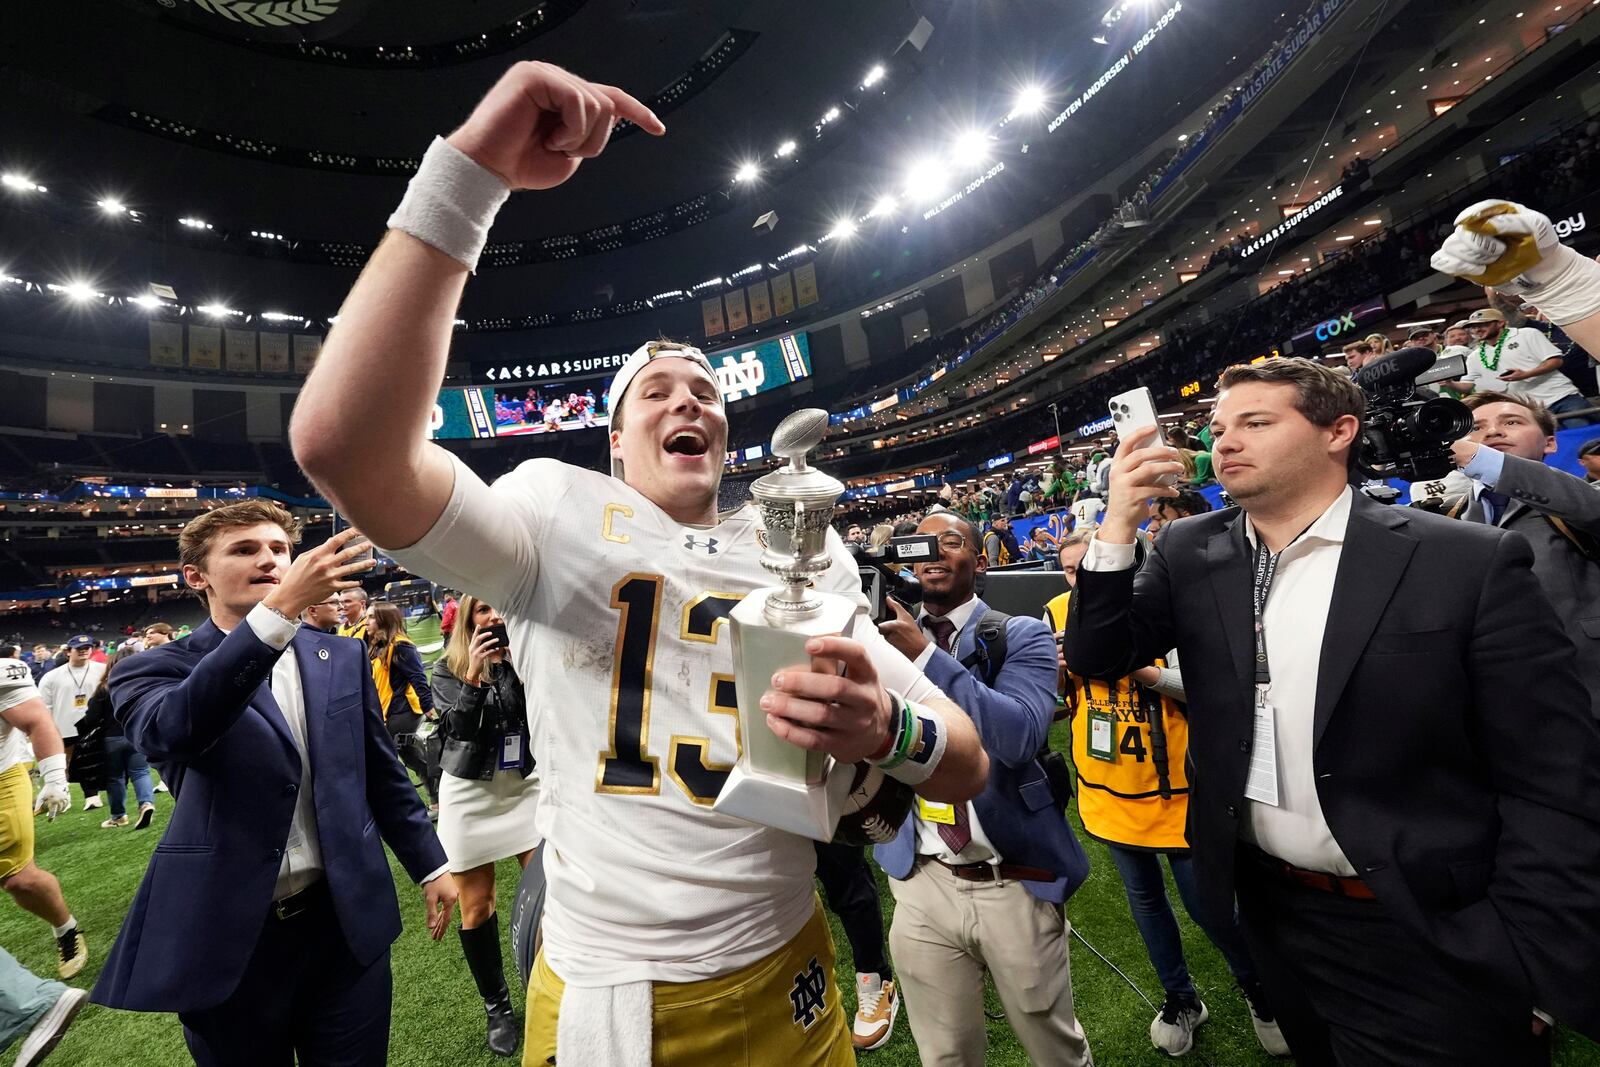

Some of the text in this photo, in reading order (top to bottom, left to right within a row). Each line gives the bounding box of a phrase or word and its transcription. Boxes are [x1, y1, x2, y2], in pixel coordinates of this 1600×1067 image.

[1048, 0, 1183, 133] MORTEN ANDERSEN 1982-1994
[1240, 54, 1285, 108] ALLSTATE
[1284, 13, 1322, 60] SUGAR
[923, 161, 1005, 220] WILL SMITH 2004-2013
[1240, 185, 1344, 258] CAESARS SUPERDOME
[1315, 311, 1357, 342] COX
[485, 360, 573, 381] CAESARS
[1362, 361, 1400, 386] RØDE
[1083, 417, 1115, 437] Ochsner
[601, 502, 634, 544] C
[1078, 504, 1086, 521] 4
[594, 571, 745, 812] 13
[1119, 725, 1148, 763] 4
[788, 955, 827, 1032] ND
